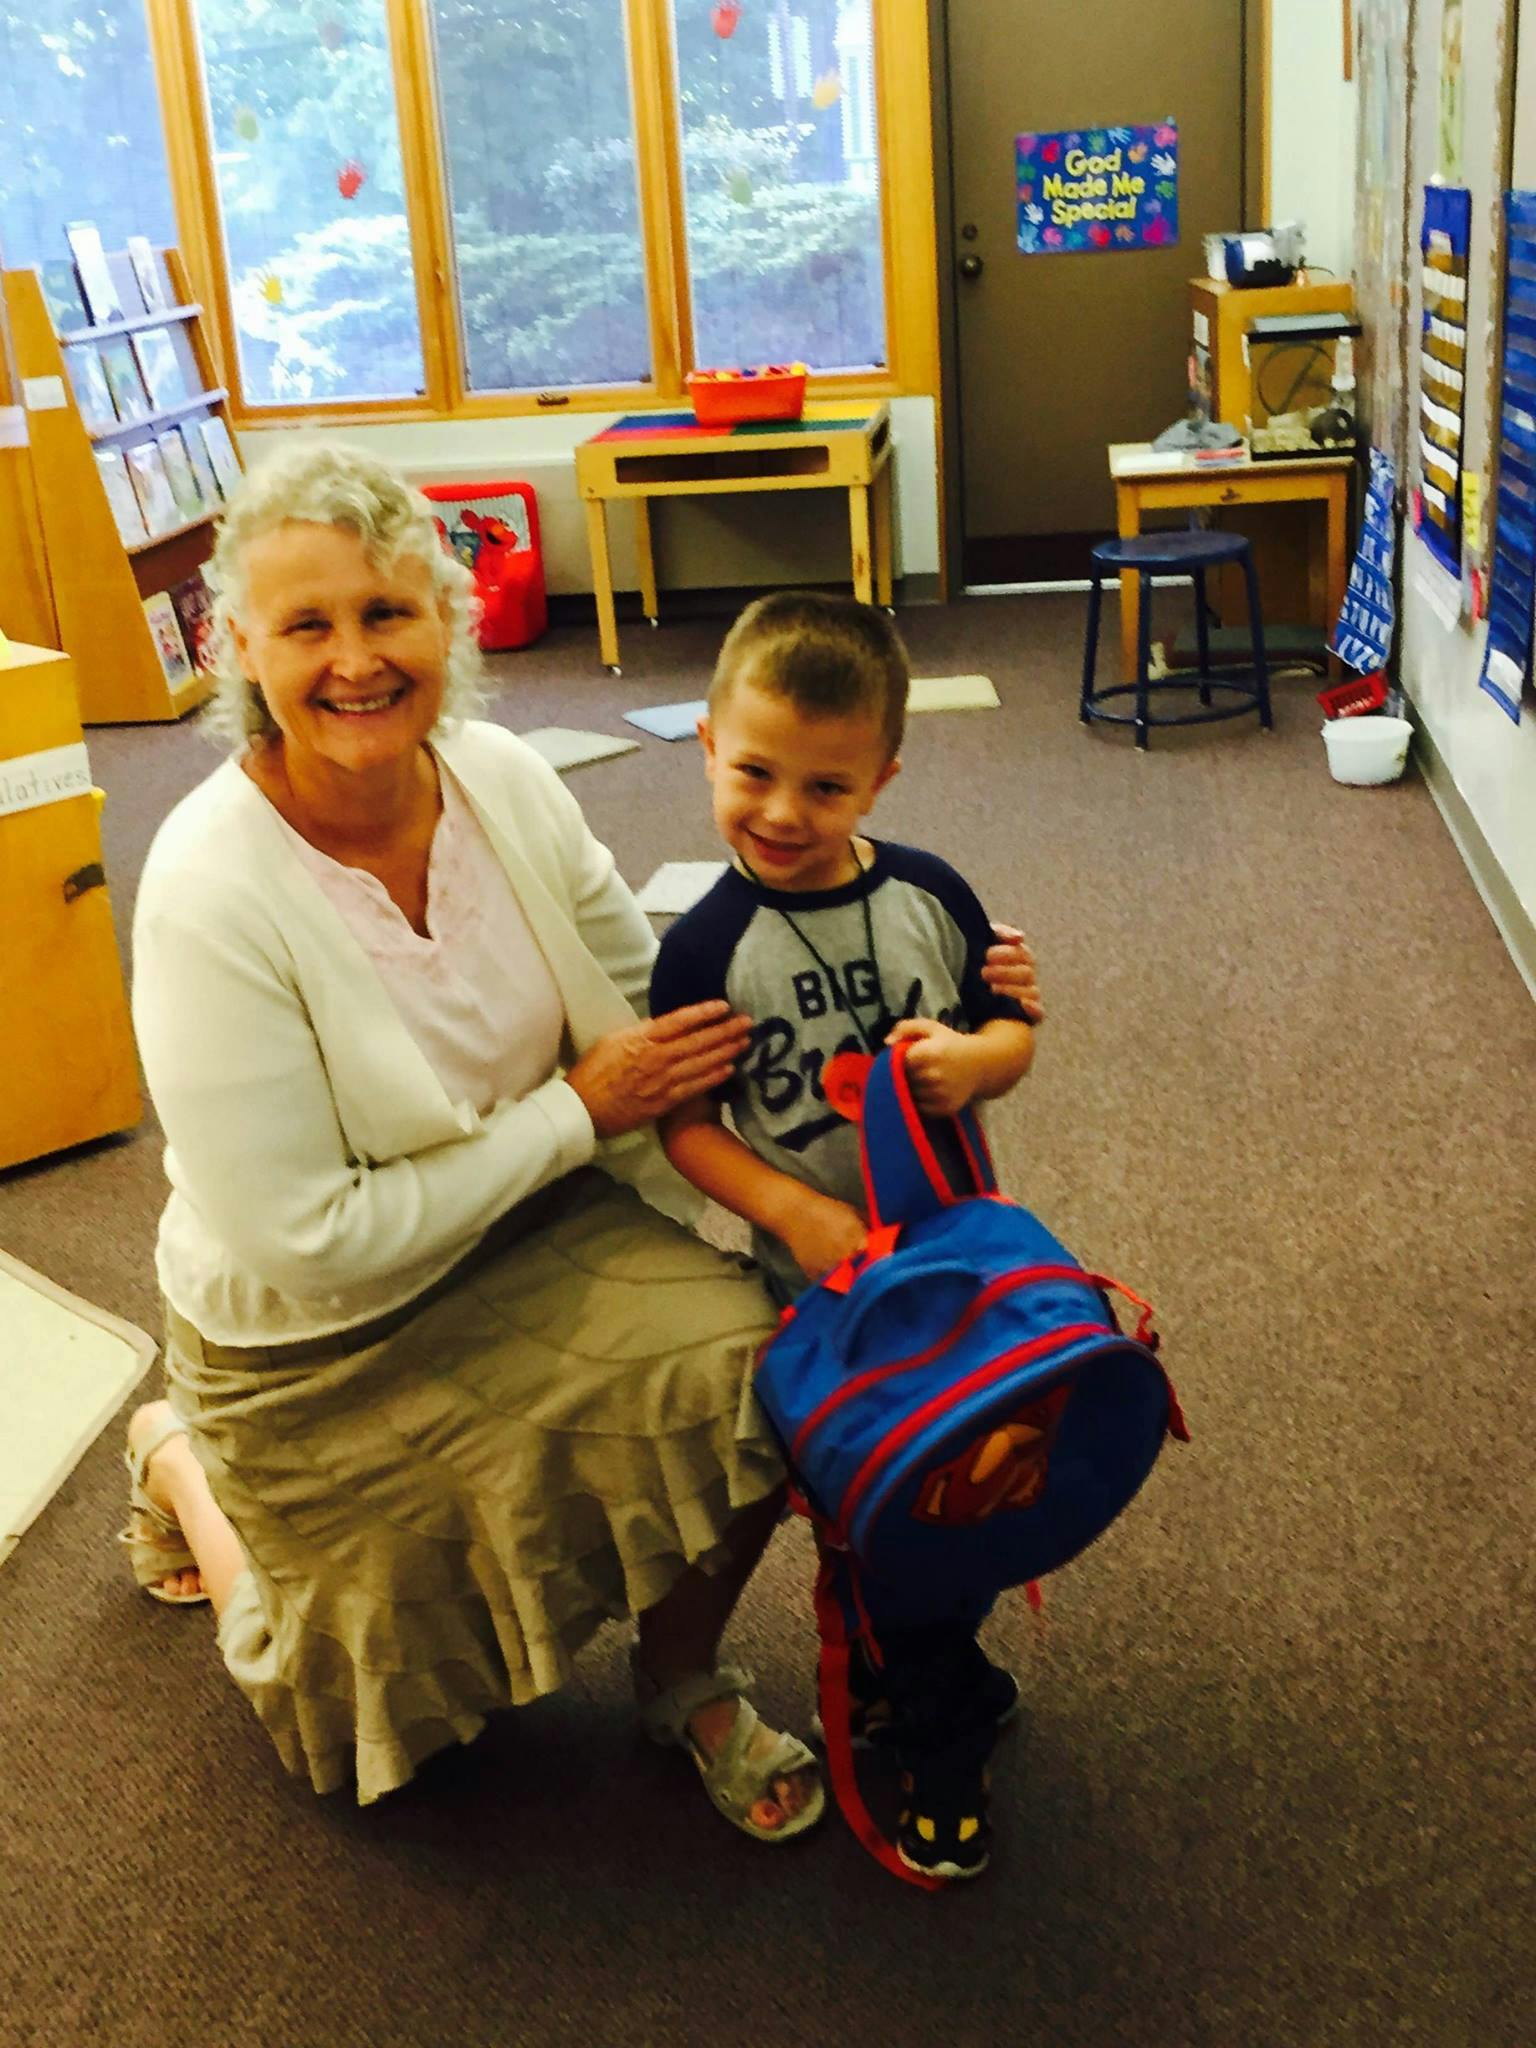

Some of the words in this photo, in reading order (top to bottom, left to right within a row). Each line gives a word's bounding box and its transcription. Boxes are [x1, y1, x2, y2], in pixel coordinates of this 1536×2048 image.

[1065, 147, 1122, 176] God
[1042, 173, 1107, 200] Made
[1112, 171, 1146, 198] Me
[1051, 197, 1137, 229] Special
[792, 959, 881, 1020] BIG
